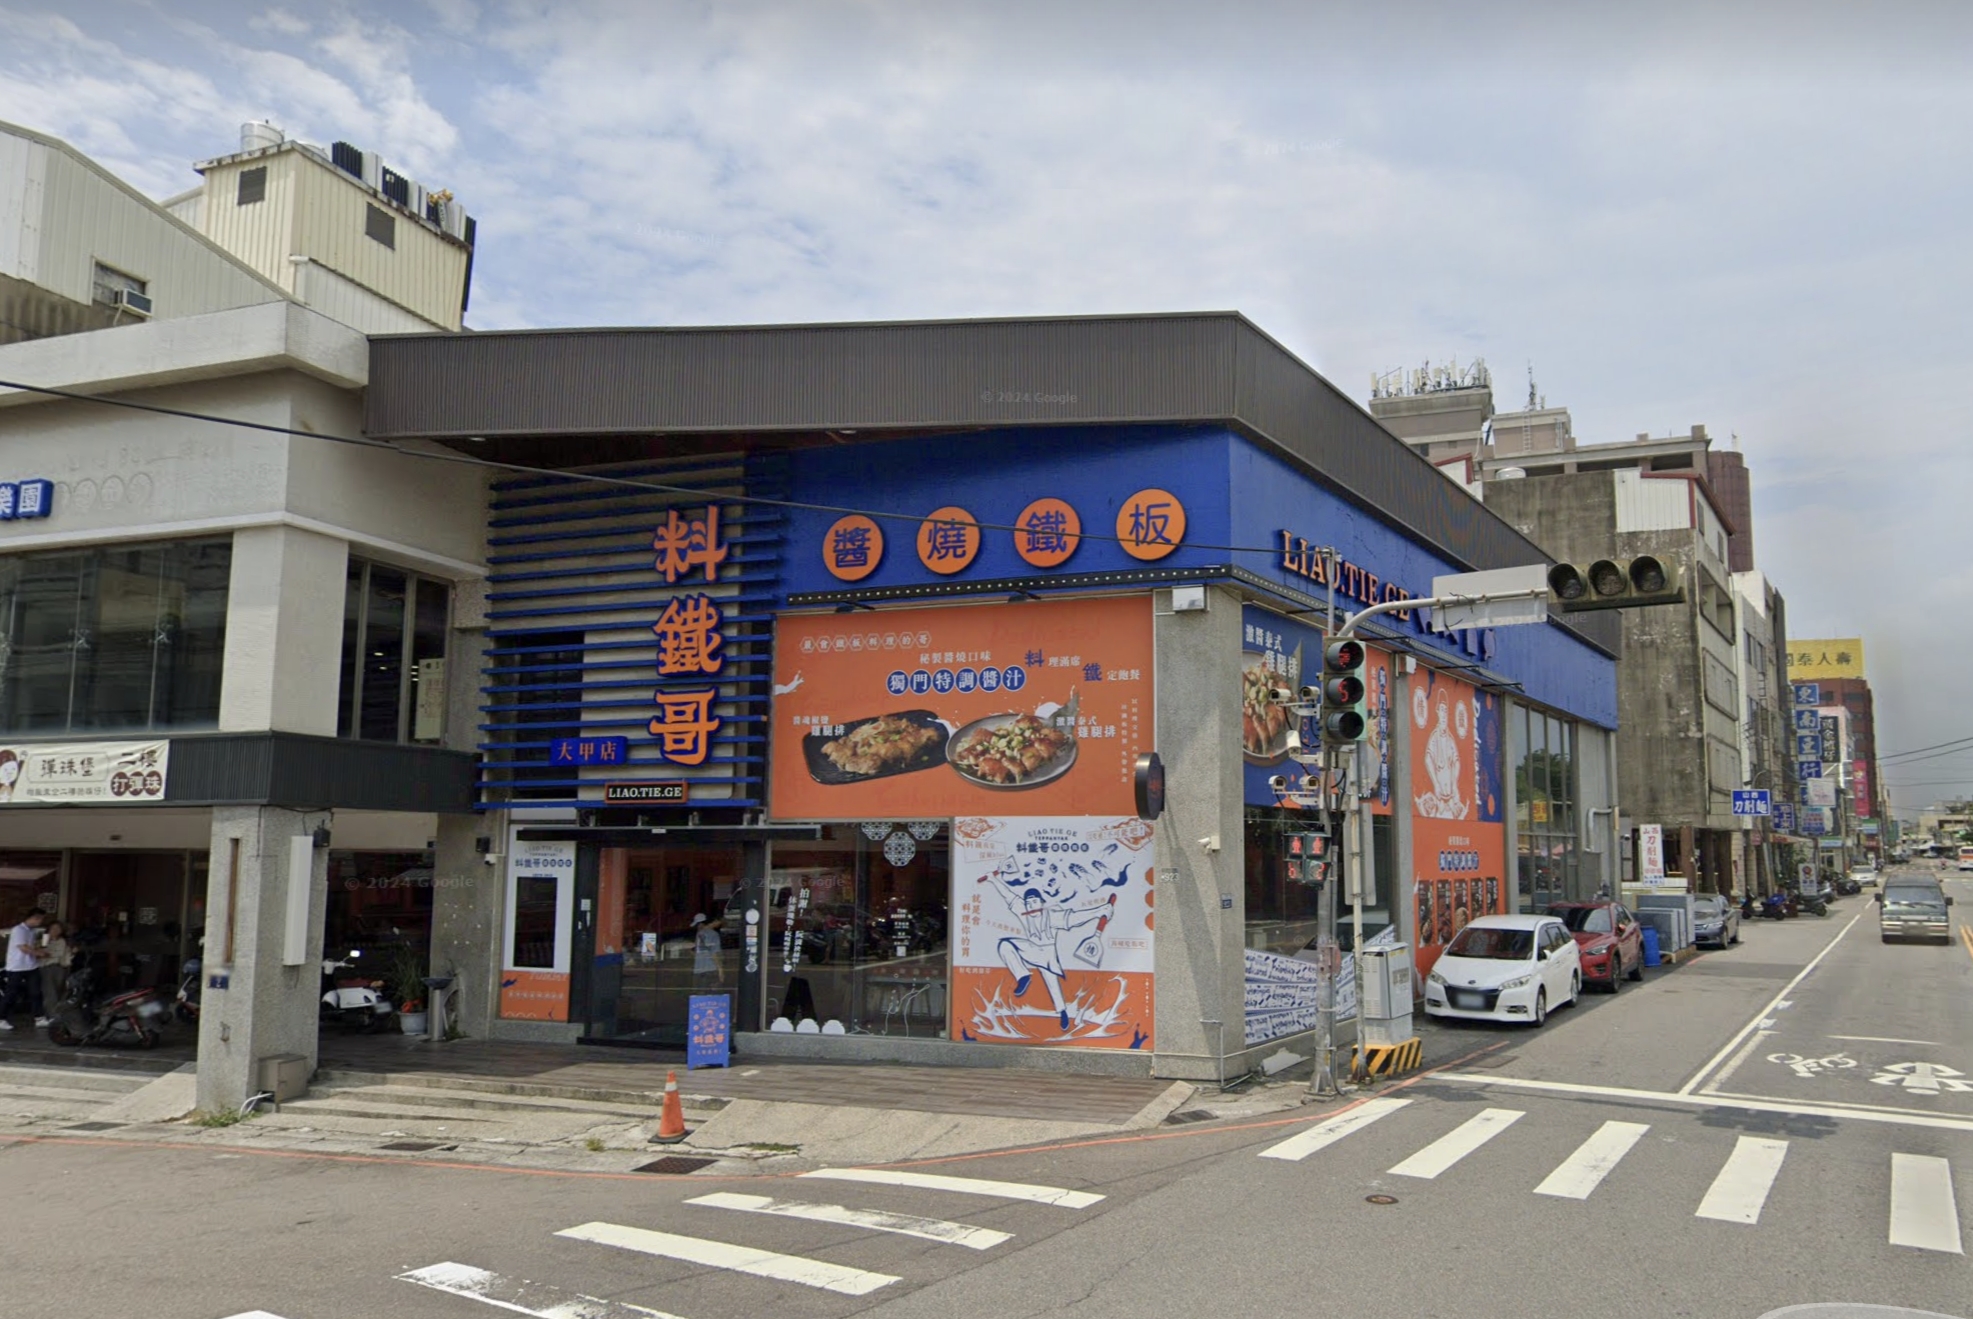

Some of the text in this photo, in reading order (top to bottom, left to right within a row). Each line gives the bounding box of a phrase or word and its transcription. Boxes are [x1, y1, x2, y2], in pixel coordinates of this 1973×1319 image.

[832, 503, 1172, 568] 醬燒鐵板
[650, 504, 727, 766] 料鐵哥
[920, 650, 992, 664] 秘製醬燒口味
[889, 667, 1023, 692] 獨門特調醬汁
[556, 740, 617, 761] 大甲店
[608, 785, 683, 799] LIAO.TIE.GE
